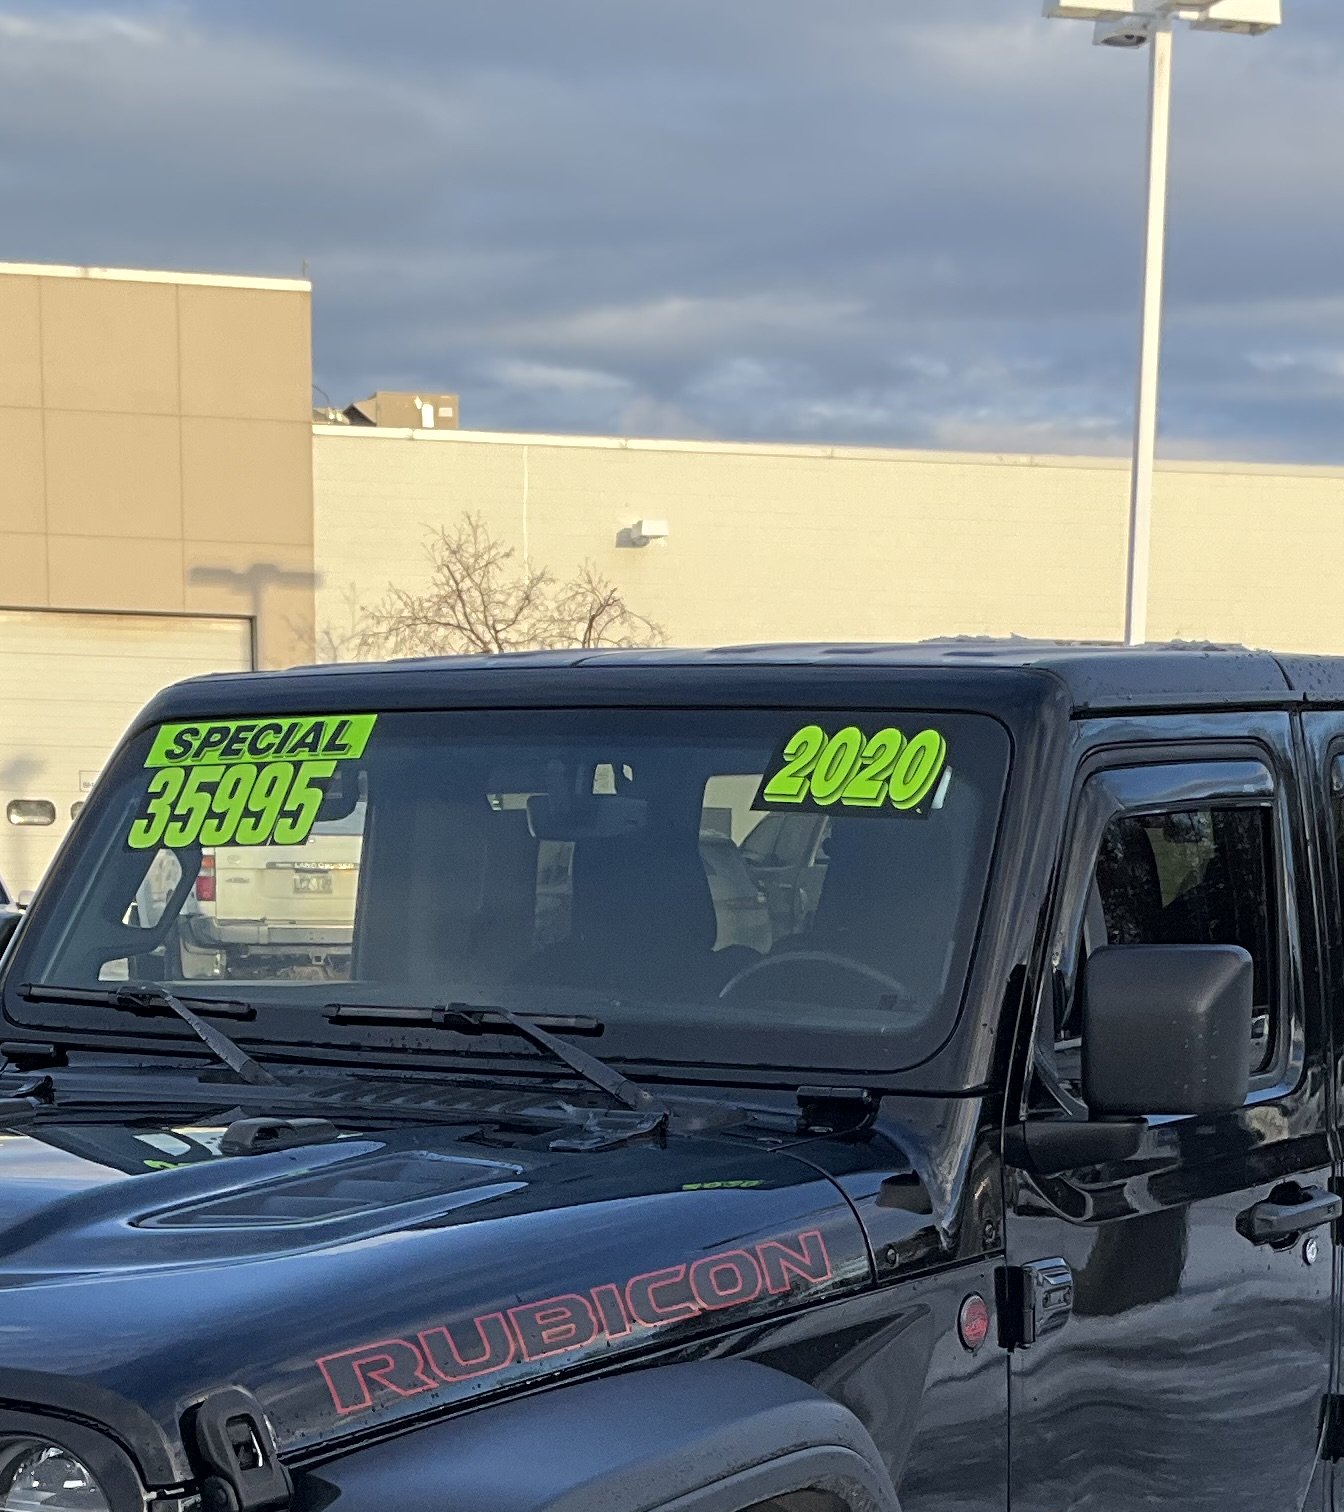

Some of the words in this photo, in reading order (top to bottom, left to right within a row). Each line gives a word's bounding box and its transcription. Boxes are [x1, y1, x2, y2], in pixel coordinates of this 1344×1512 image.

[164, 719, 353, 763] SPECIAL
[763, 724, 947, 810] 2020
[128, 760, 338, 849] 35995
[316, 1230, 832, 1414] RUBICON
